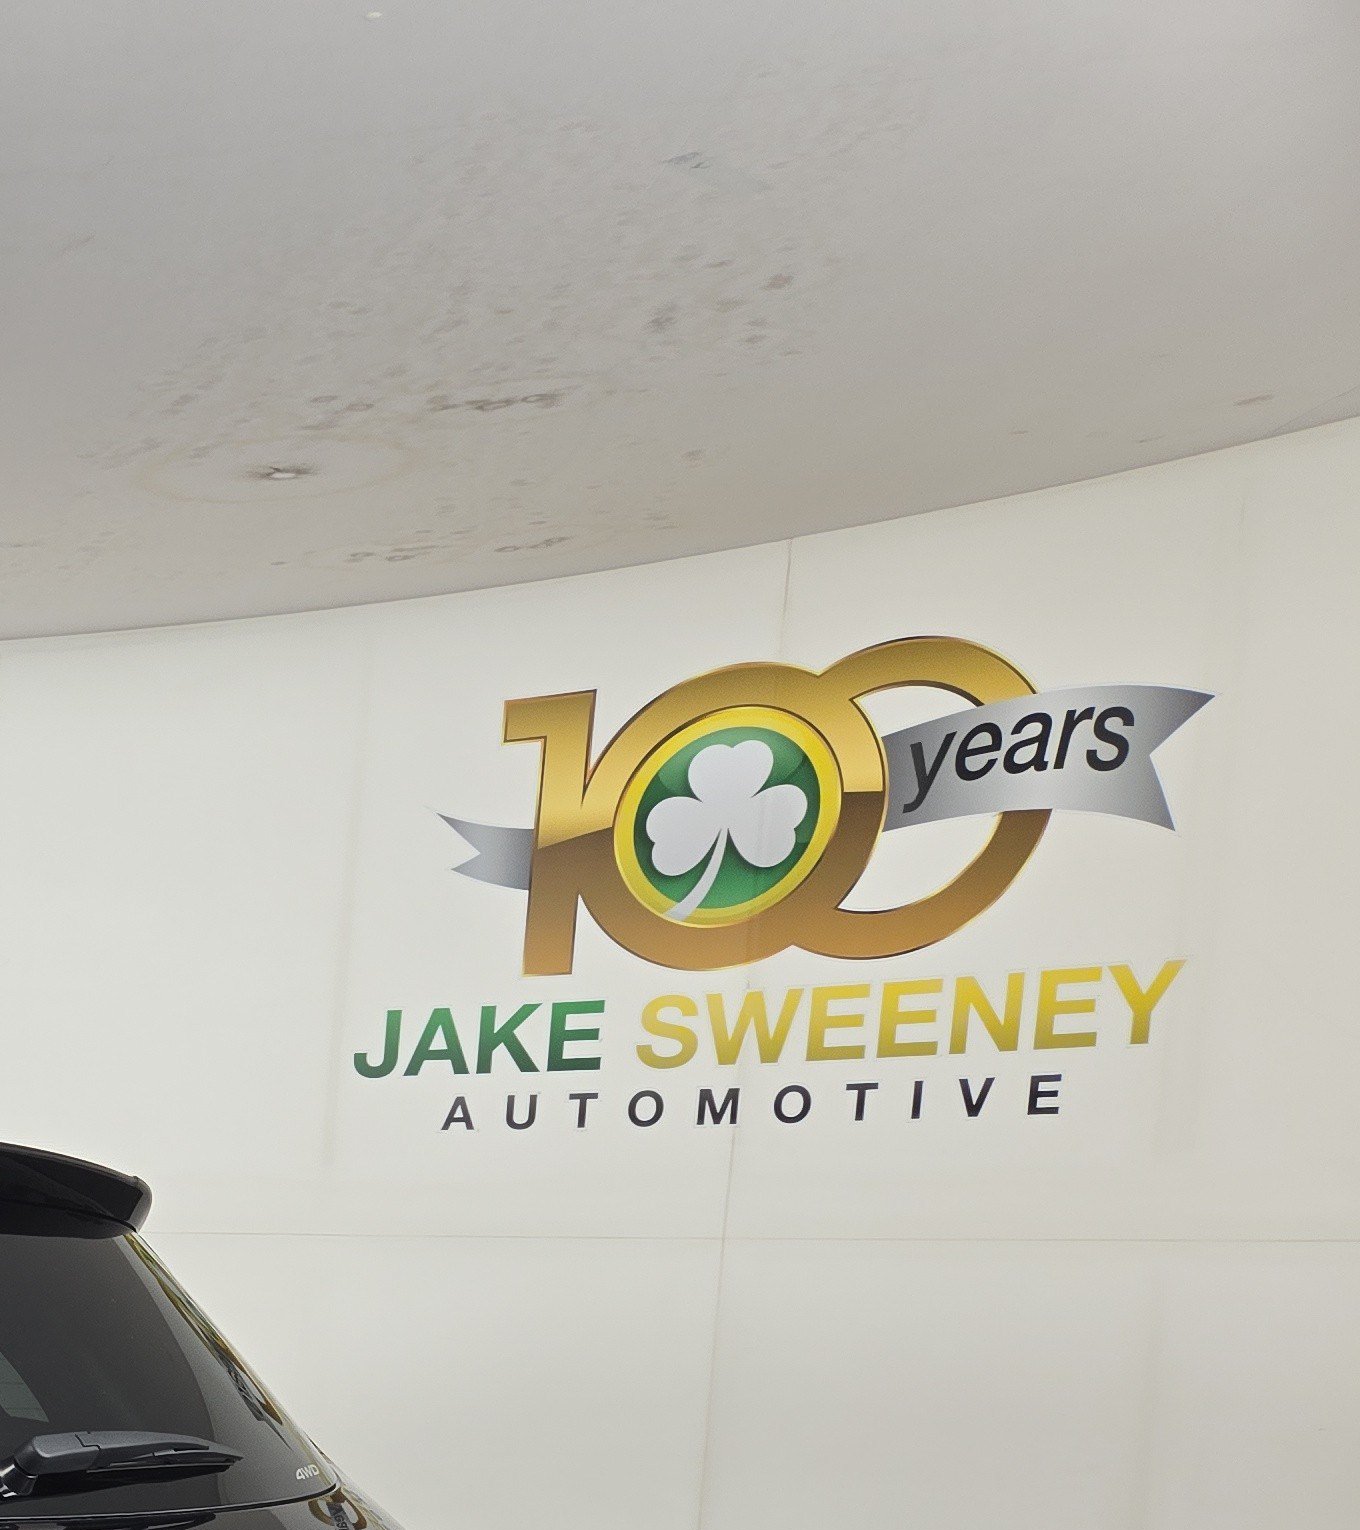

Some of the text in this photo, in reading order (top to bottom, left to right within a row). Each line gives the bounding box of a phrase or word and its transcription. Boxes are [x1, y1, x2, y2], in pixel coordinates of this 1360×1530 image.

[502, 635, 1137, 977] 100 years
[353, 959, 1186, 1079] JAKE SWEENEY
[441, 1073, 1063, 1132] AUTOMOTIVE
[295, 1464, 320, 1480] 4WD
